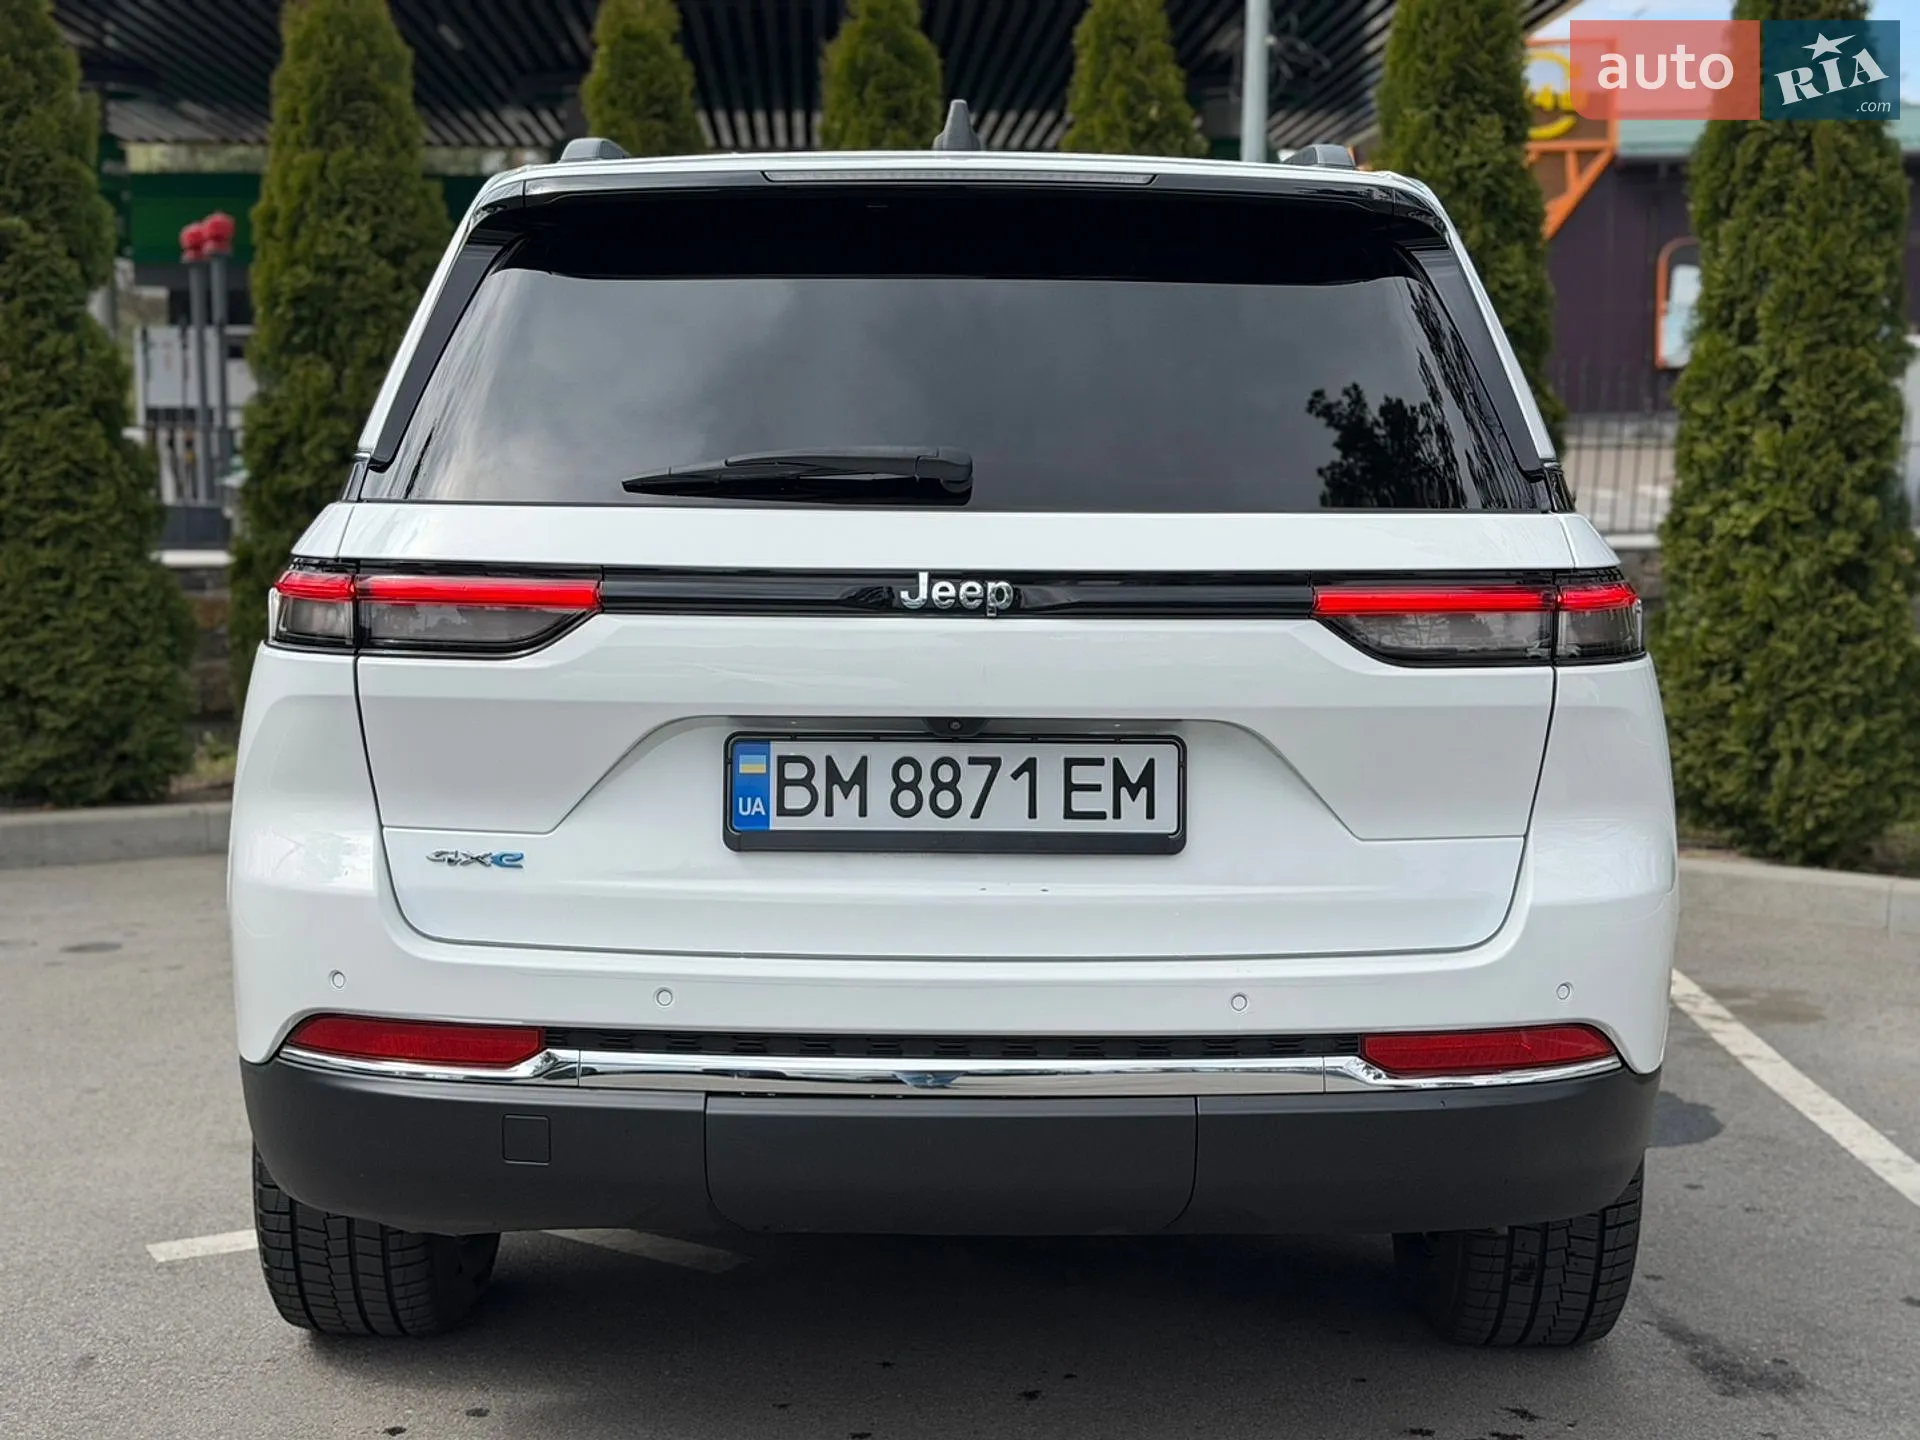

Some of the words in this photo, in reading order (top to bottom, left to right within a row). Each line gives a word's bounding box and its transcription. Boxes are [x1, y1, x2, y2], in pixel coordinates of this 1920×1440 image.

[900, 571, 1014, 617] Jeep
[738, 797, 766, 817] UA
[775, 754, 868, 818] BM
[889, 755, 1038, 820] 8871
[1062, 757, 1156, 821] EM
